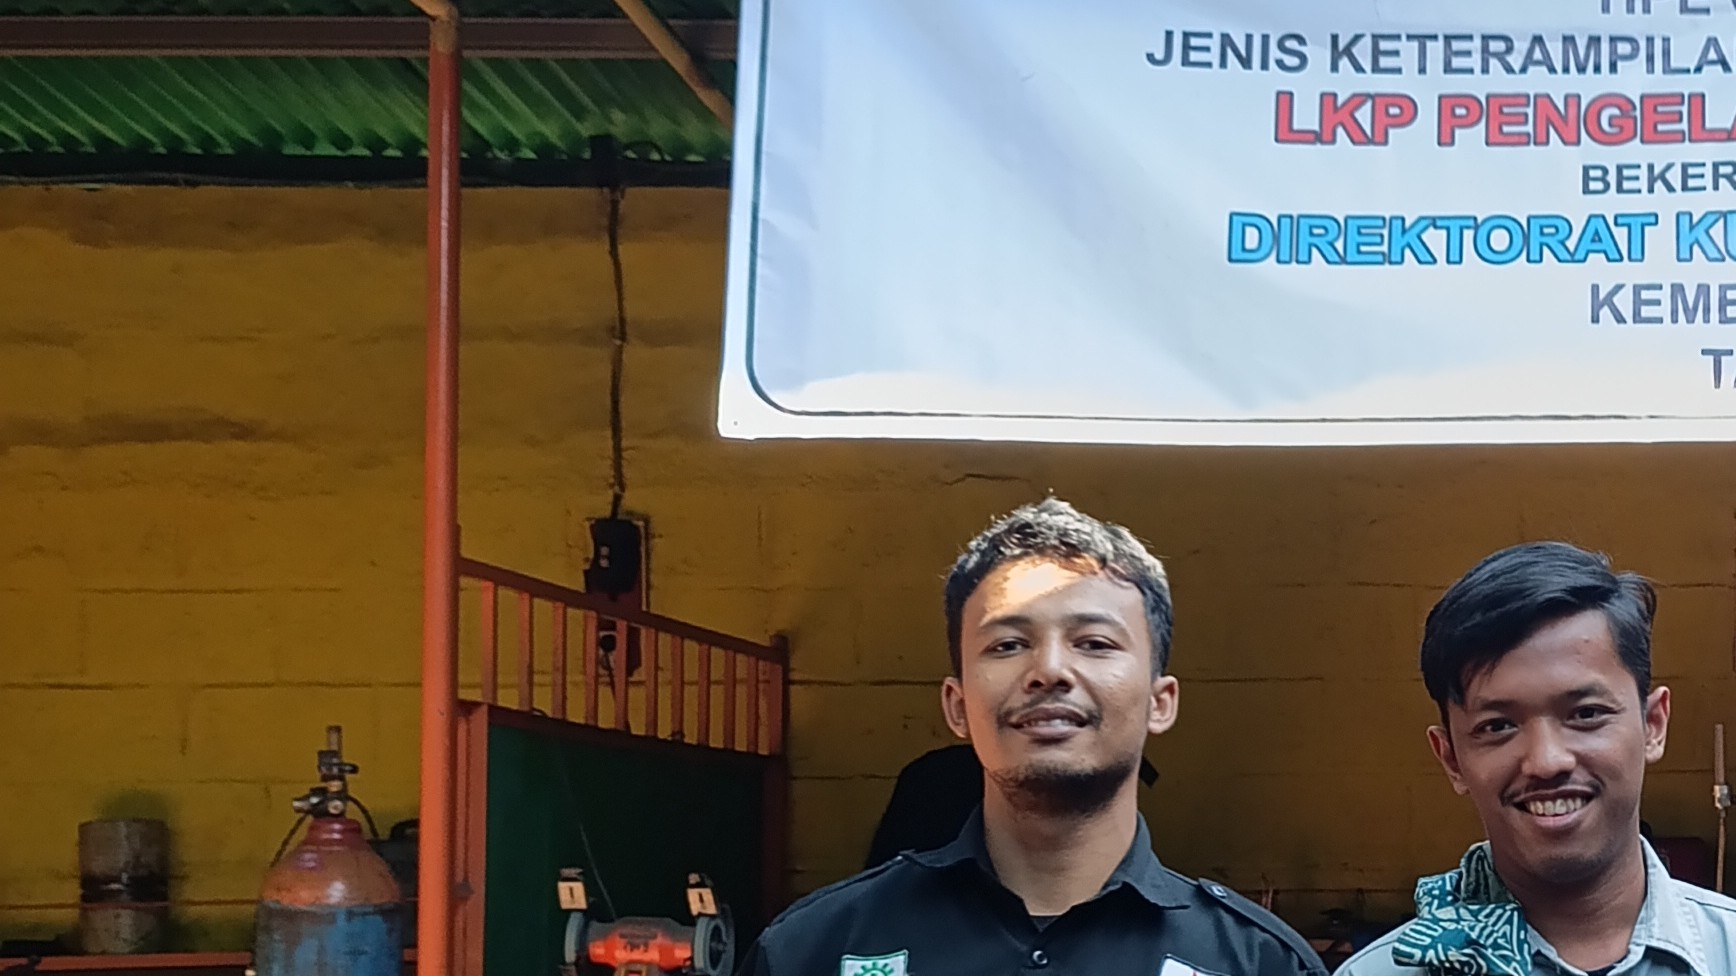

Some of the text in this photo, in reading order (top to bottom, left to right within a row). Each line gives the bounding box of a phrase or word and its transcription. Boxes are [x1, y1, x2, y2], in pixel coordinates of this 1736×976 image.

[1146, 30, 1309, 73] JENIS
[1274, 90, 1419, 147] LKP
[1227, 211, 1660, 267] DIREKTORAT
